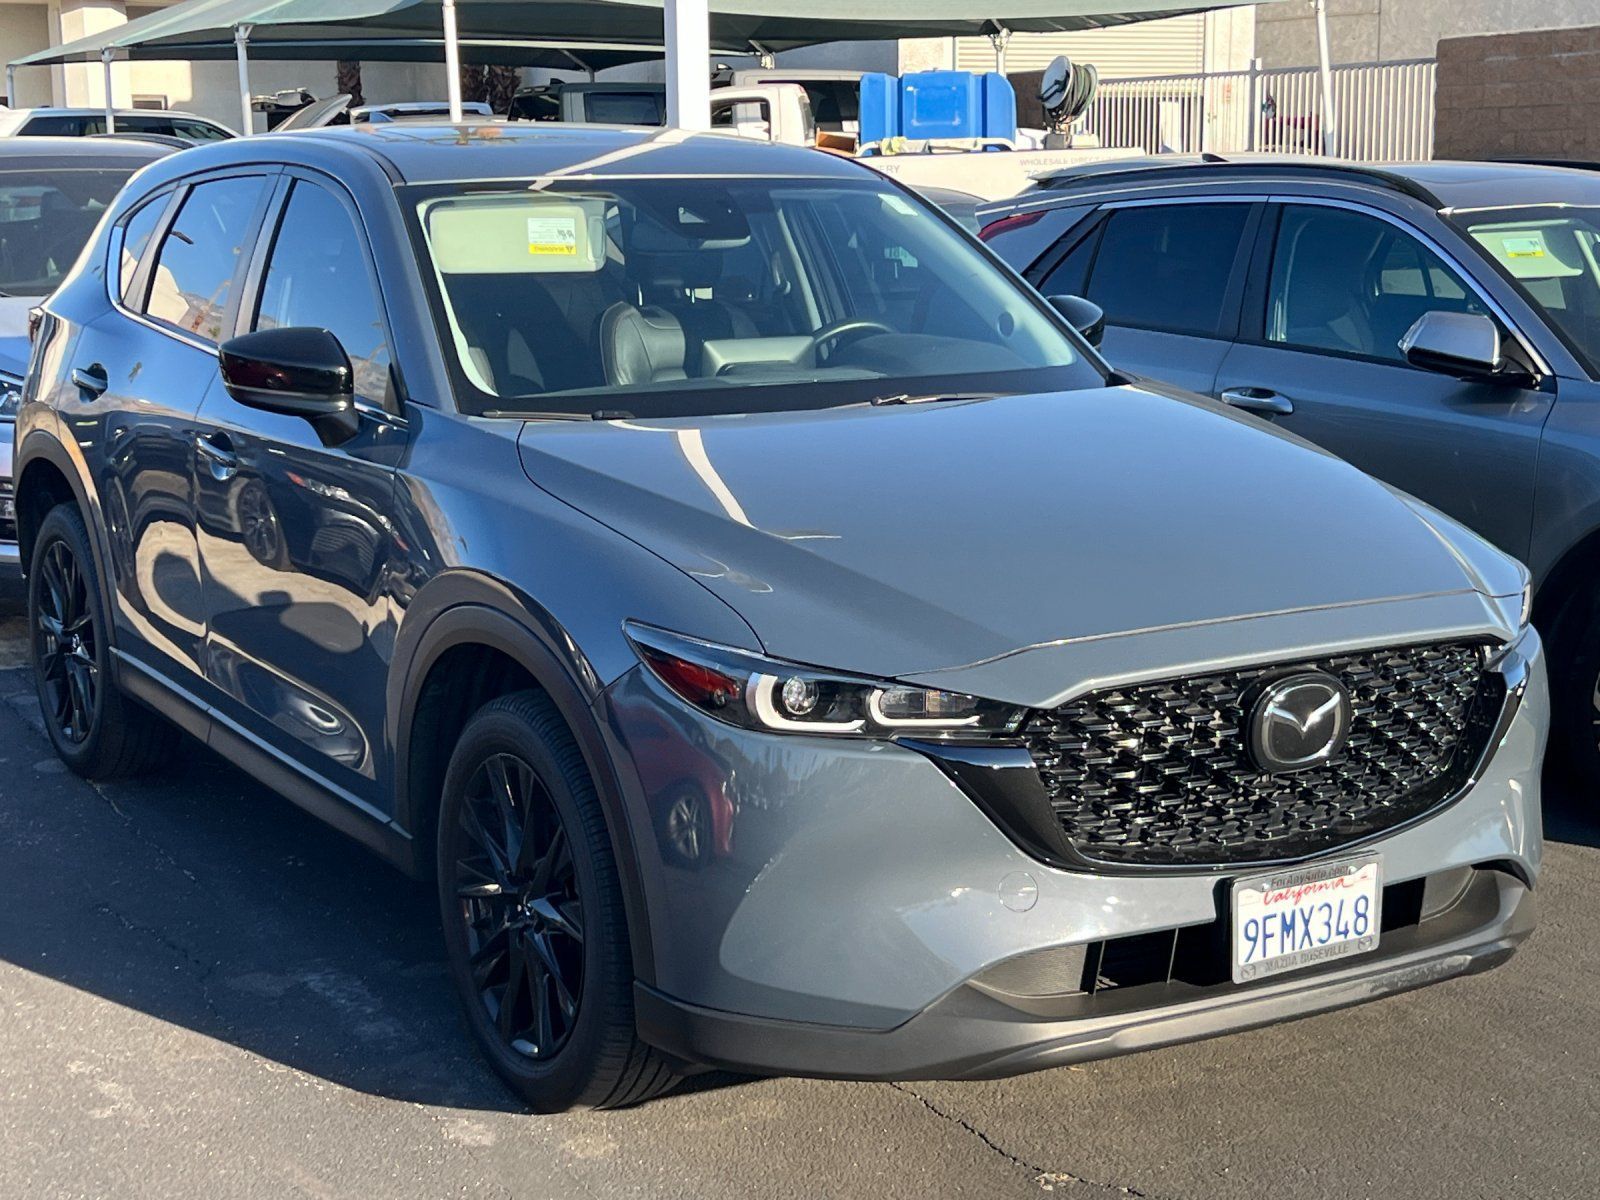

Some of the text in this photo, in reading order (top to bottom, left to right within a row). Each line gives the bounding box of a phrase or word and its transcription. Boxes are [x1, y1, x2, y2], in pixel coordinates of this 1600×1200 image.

[1019, 157, 1068, 167] WHOLESALE
[1263, 877, 1354, 905] California
[1244, 894, 1369, 963] 9FMX348
